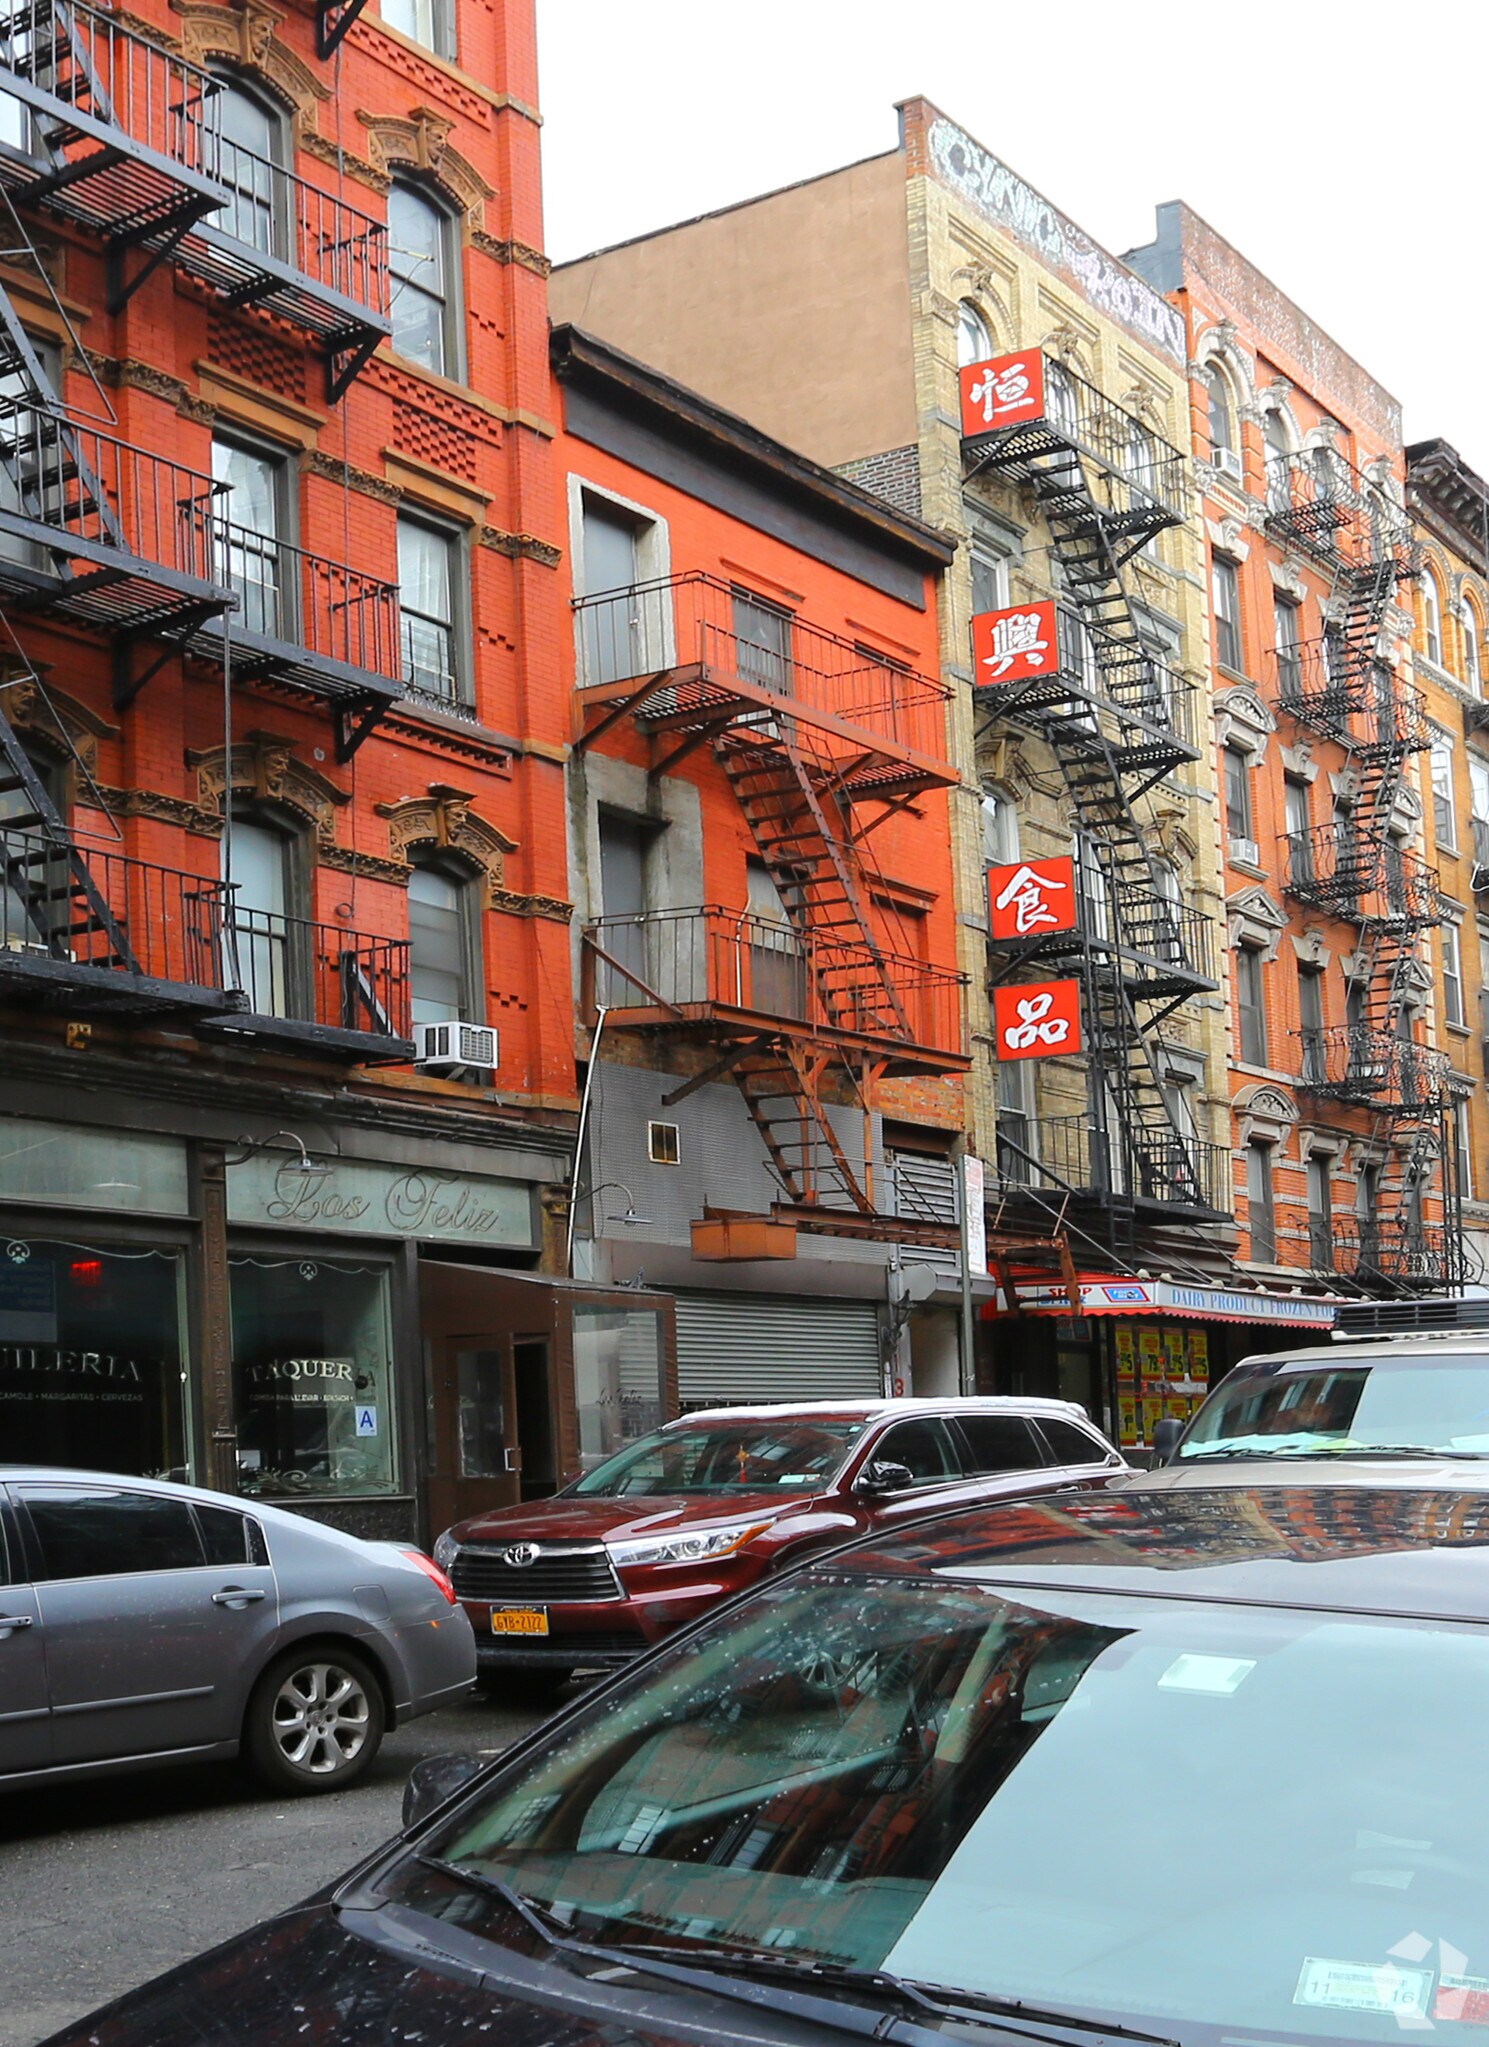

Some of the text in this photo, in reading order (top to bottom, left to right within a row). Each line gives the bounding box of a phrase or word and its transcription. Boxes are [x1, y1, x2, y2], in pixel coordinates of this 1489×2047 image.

[969, 363, 1035, 423] 恒
[996, 866, 1067, 933] 食
[1005, 993, 1069, 1049] 品
[267, 1155, 499, 1231] Los Feliz
[1049, 1287, 1093, 1297] SHP
[1172, 1289, 1206, 1308] DAIRY
[1210, 1294, 1265, 1313] PRODUCT
[1269, 1300, 1312, 1317] FROZEN
[41, 1393, 94, 1401] MARGARITAS
[102, 1393, 143, 1402] CERVEZAS
[360, 1410, 374, 1428] A
[1310, 1980, 1331, 1995] 11
[1392, 1989, 1415, 2004] 16
